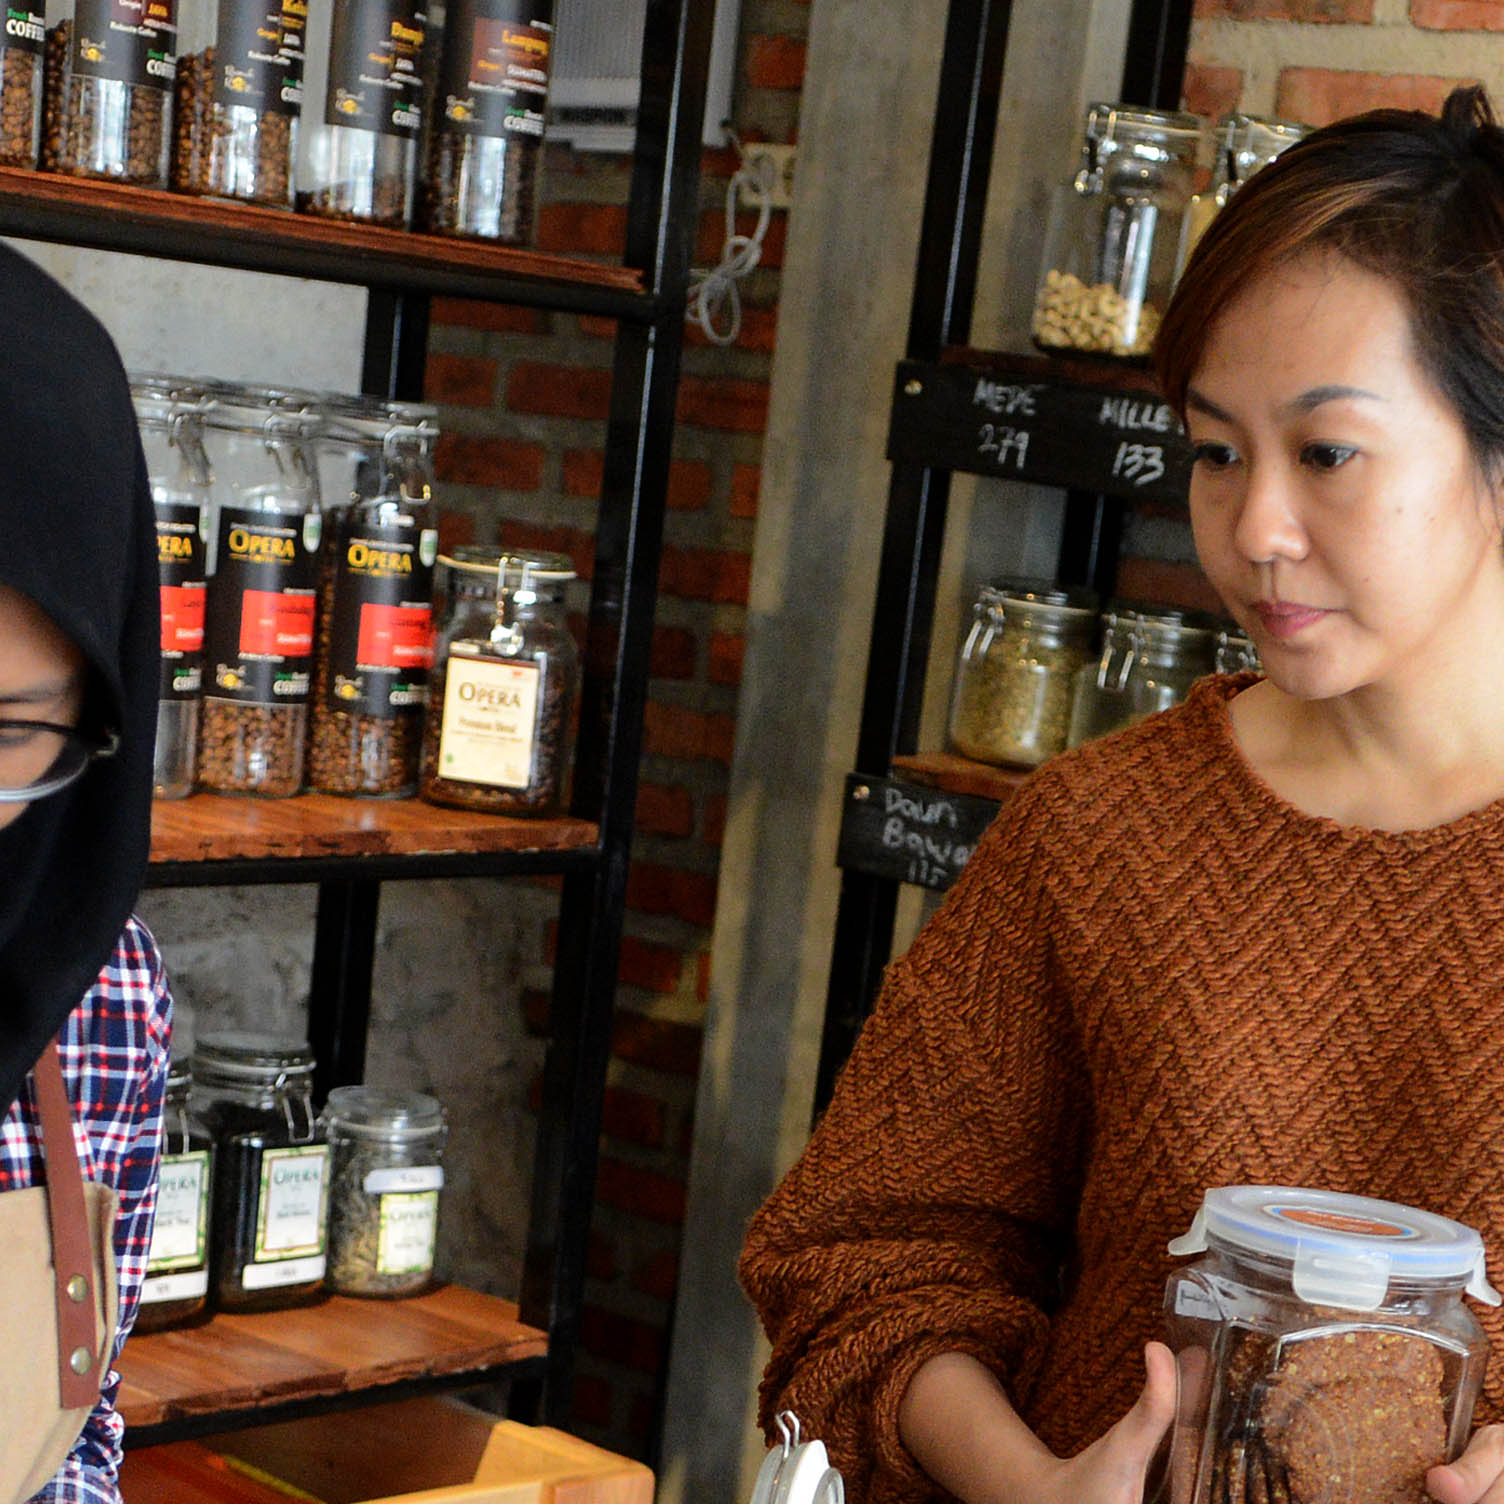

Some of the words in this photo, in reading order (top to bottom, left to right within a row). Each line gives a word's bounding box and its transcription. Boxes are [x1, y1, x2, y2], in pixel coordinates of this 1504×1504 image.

[978, 423, 1032, 471] 279
[1111, 441, 1165, 486] 133
[228, 529, 296, 559] OPERA
[347, 543, 413, 574] OPERA
[459, 681, 521, 709] OPERA
